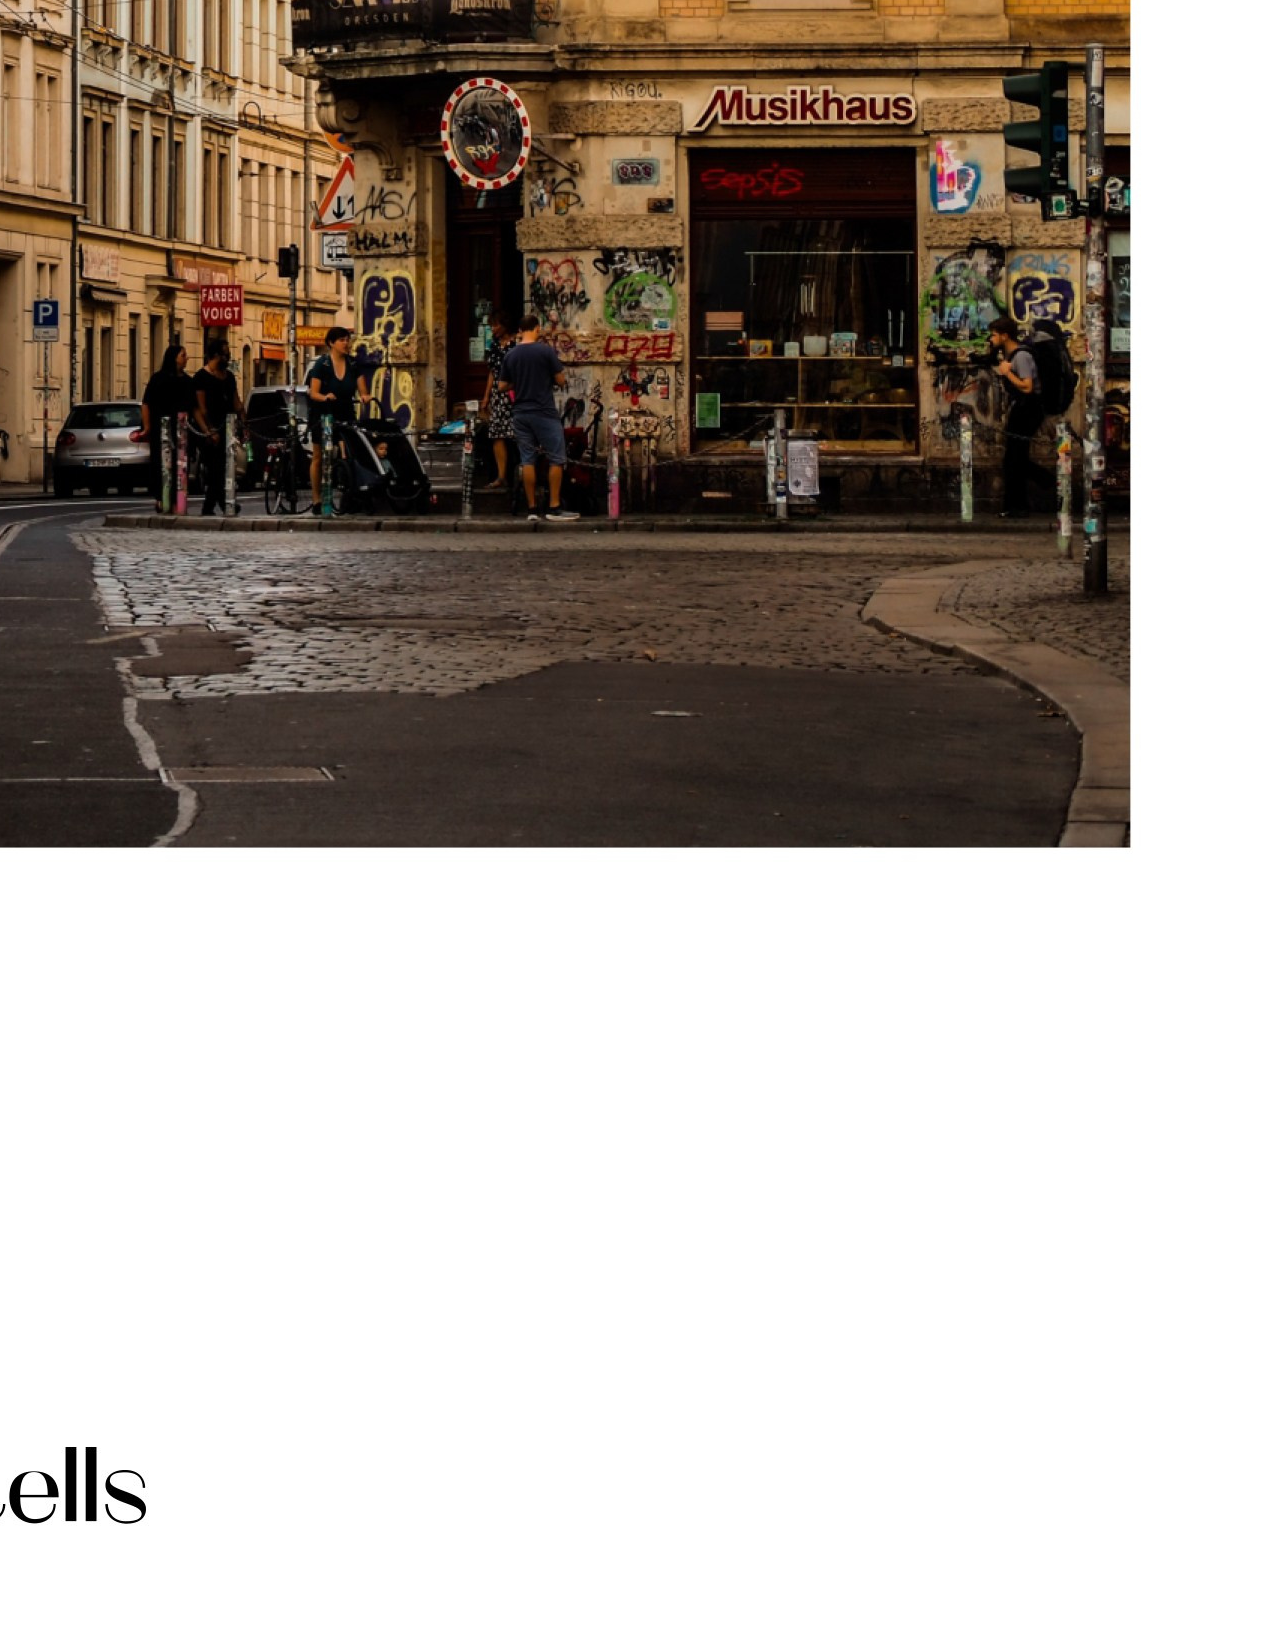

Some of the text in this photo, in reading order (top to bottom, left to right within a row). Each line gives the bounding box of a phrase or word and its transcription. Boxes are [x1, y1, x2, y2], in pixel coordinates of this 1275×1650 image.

[344, 12, 410, 26] DRESDEN
[690, 87, 915, 130] Musikhaus
[201, 287, 240, 303] FARBEN
[38, 302, 53, 325] P
[201, 307, 241, 321] VOIGT
